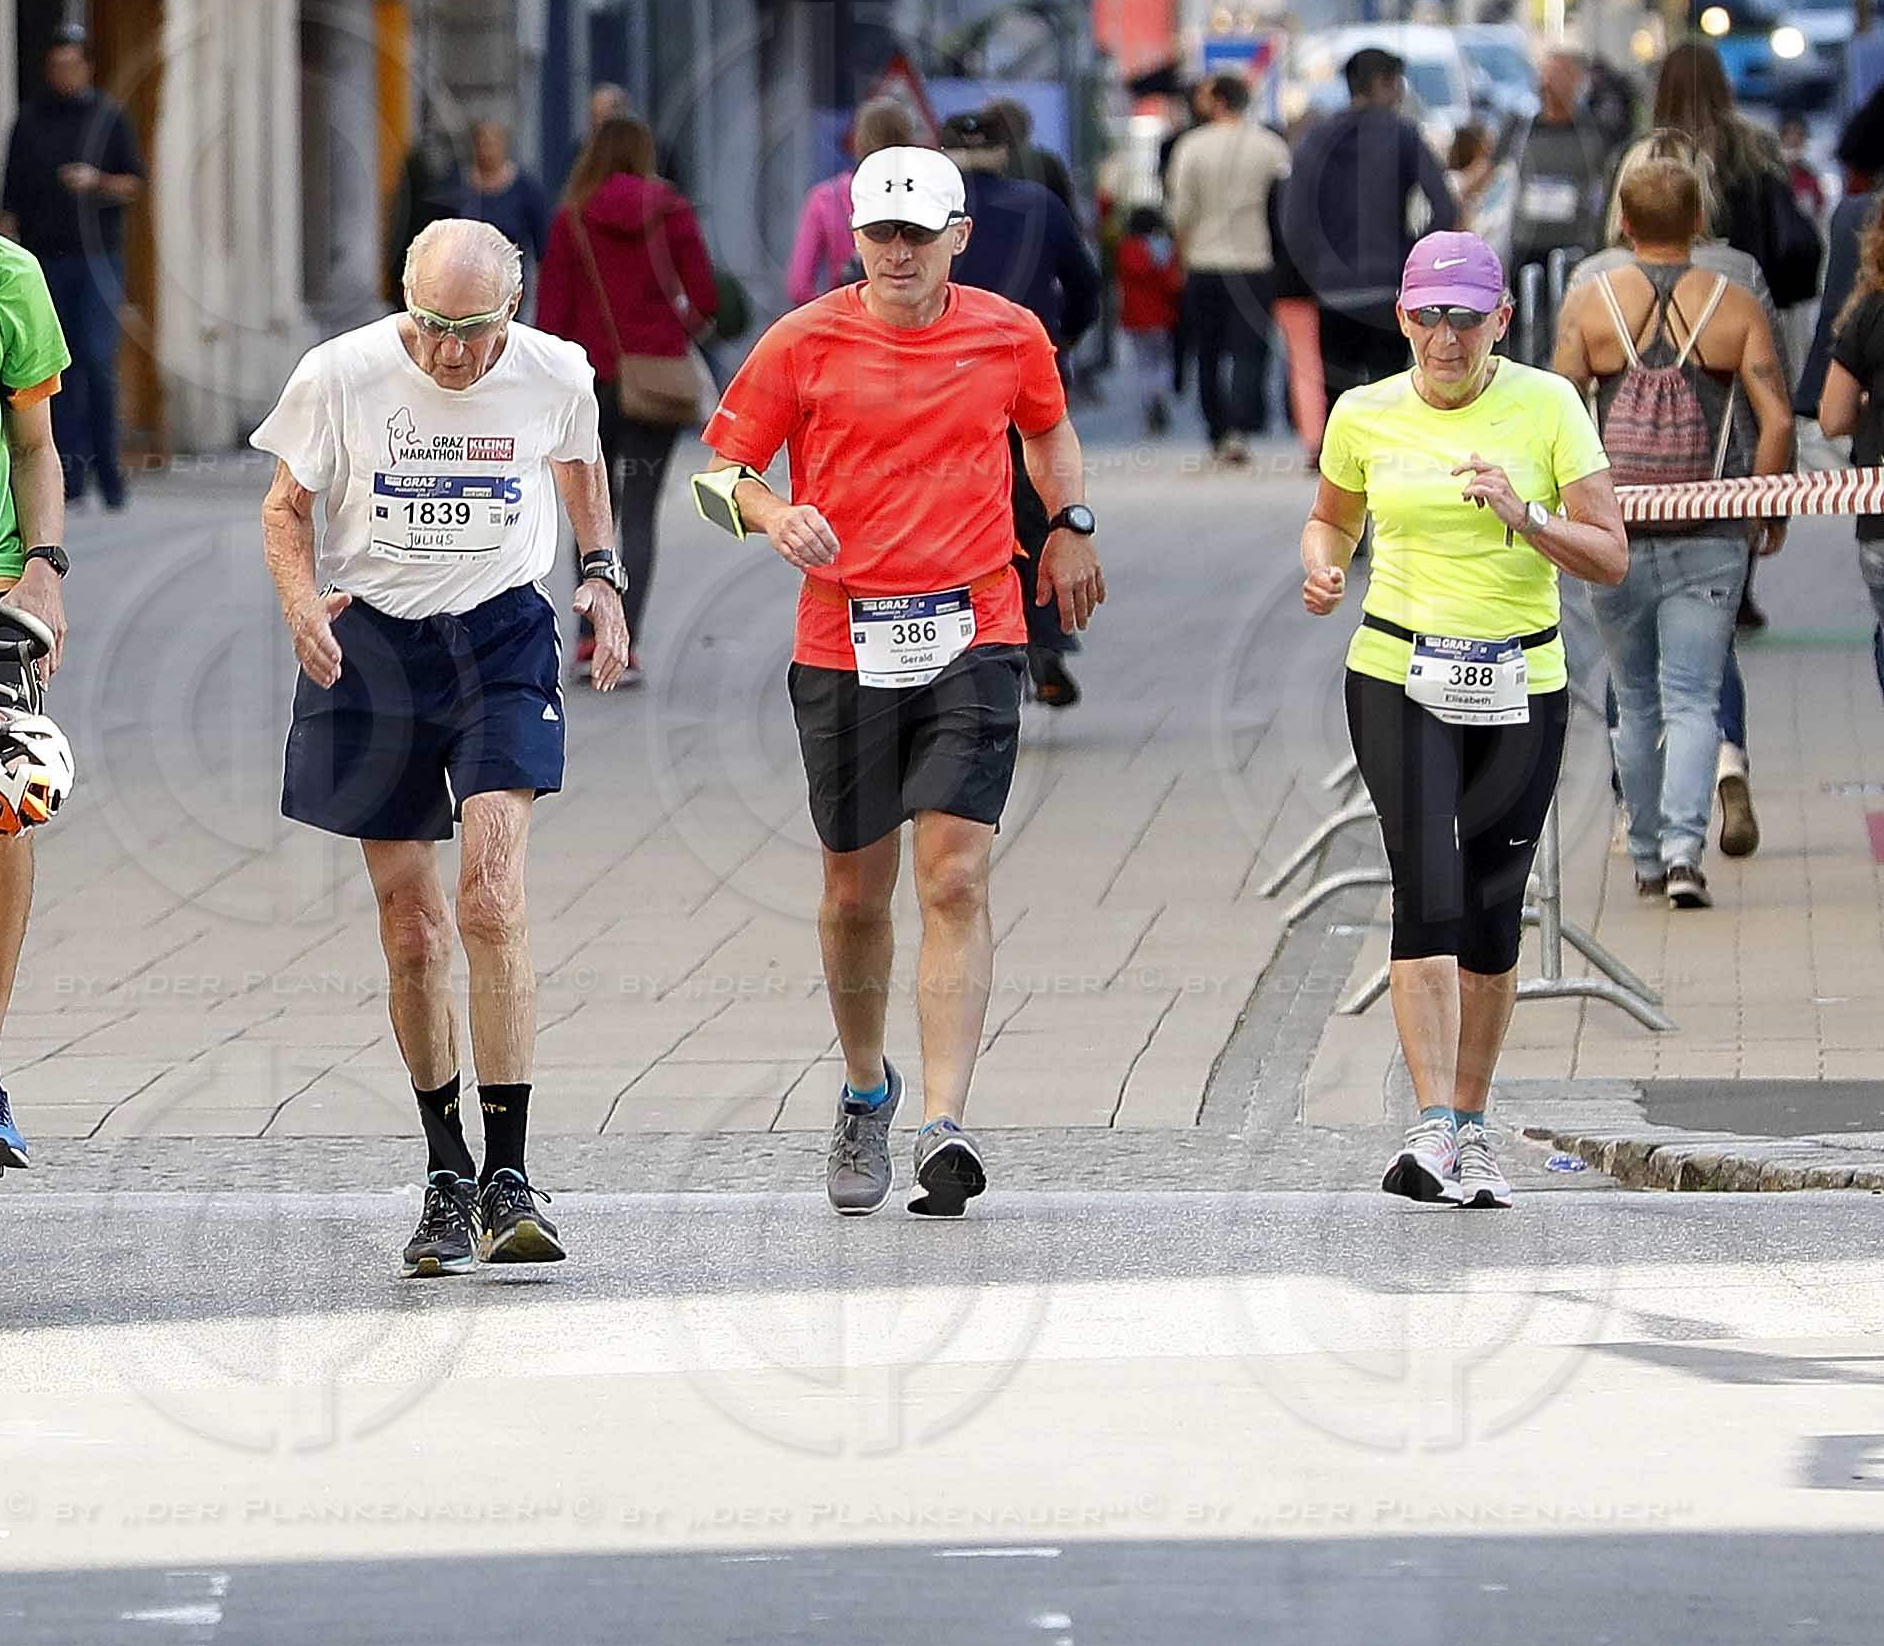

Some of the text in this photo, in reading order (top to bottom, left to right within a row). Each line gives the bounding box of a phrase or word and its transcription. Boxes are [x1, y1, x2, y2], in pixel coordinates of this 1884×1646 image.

[432, 436, 464, 448] GRAZ
[469, 439, 513, 451] KLEINE
[399, 448, 464, 461] MARATHON
[403, 501, 471, 526] 1839
[891, 620, 937, 645] 386
[1448, 664, 1494, 687] 388
